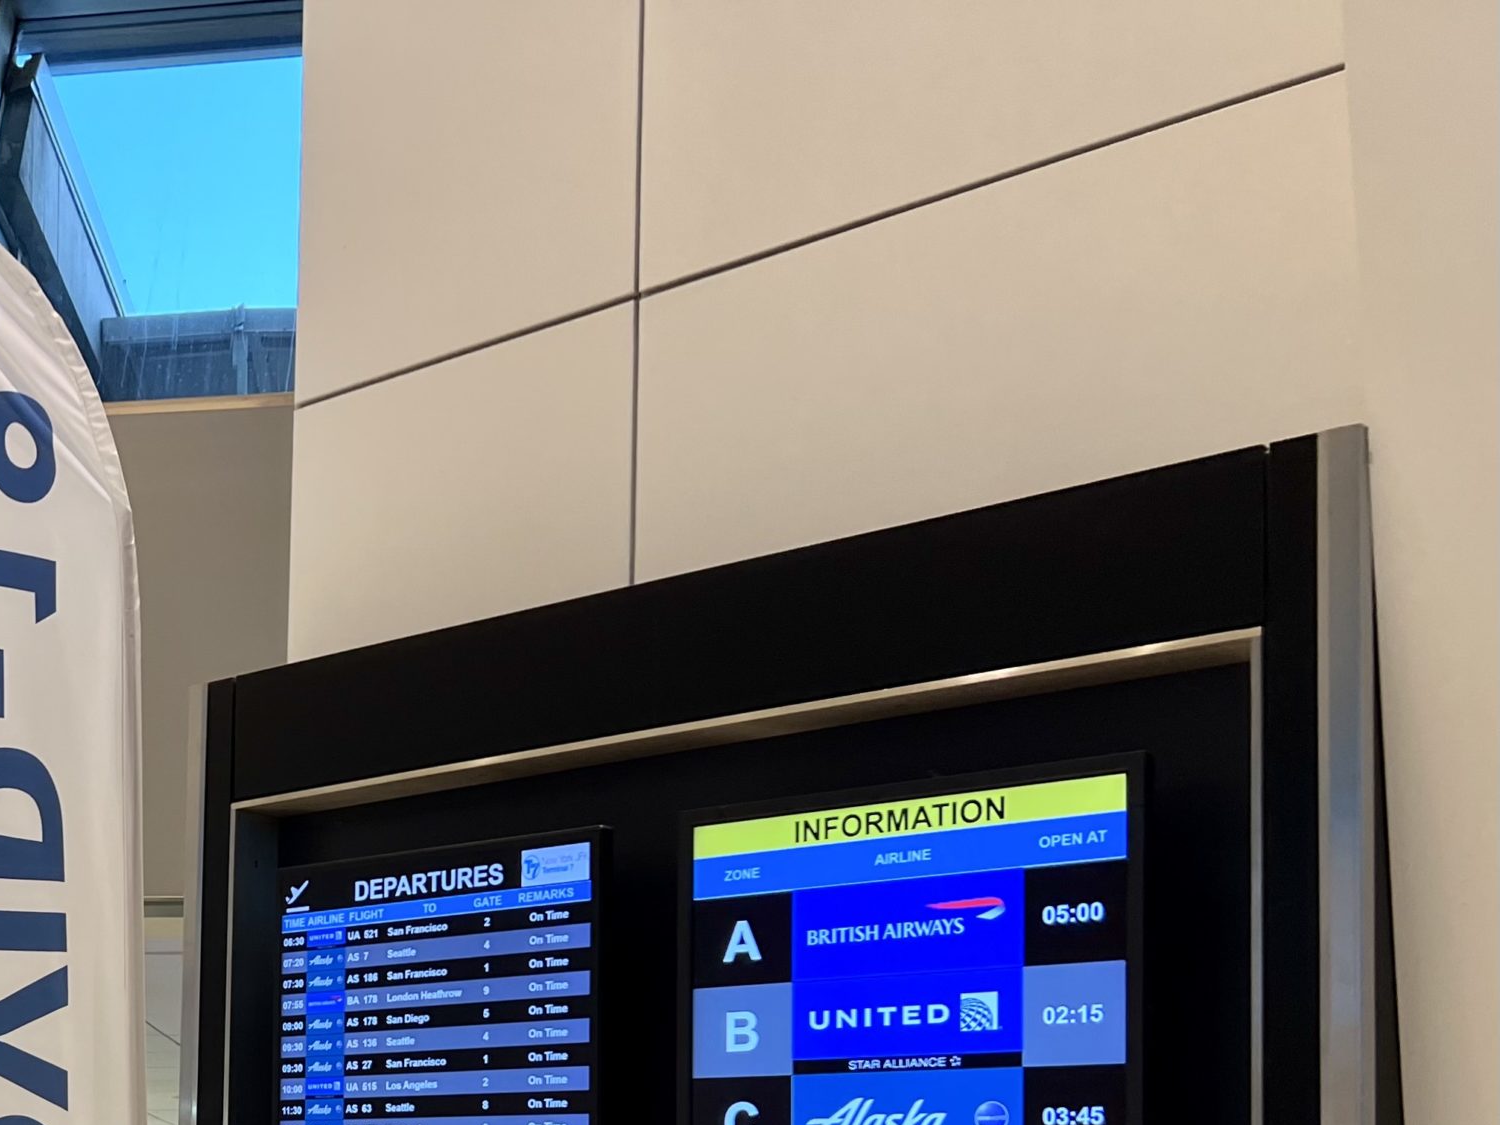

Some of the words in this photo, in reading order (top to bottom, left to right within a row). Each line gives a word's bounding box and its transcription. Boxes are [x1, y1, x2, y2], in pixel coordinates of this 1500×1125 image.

[794, 796, 1006, 843] INFORMATION
[724, 867, 760, 881] ZONE
[874, 849, 931, 865] AIRLINE
[1038, 832, 1082, 849] OPEN
[1085, 830, 1108, 844] AT
[354, 863, 504, 901] DEPARTURES
[284, 918, 305, 928] TIME
[308, 913, 344, 926] AIRLINE
[349, 909, 384, 921] FLIGHT
[423, 903, 437, 913] TO
[473, 895, 502, 908] GATE
[518, 887, 574, 903] REMARKS
[347, 931, 360, 940] UA
[387, 927, 404, 937] San
[405, 922, 448, 935] Francisco
[483, 917, 491, 927] 2
[529, 912, 544, 922] On
[545, 910, 570, 920] Time
[722, 921, 762, 963] A
[807, 924, 879, 946] BRITISH
[883, 918, 965, 939] AIRWAYS
[1042, 902, 1104, 925] 05:00
[347, 953, 360, 962] AS
[387, 948, 416, 958] Seattle
[483, 940, 490, 950] 4
[529, 936, 544, 945] On
[545, 934, 570, 944] Time
[346, 974, 360, 984] AS
[386, 972, 404, 981] San
[404, 968, 448, 979] Francisco
[483, 962, 490, 972] 1
[528, 959, 543, 968] On
[545, 957, 570, 967] Time
[386, 991, 419, 1002] London
[420, 989, 462, 1000] Heathrow
[528, 982, 543, 992] On
[544, 980, 569, 990] Time
[346, 1018, 359, 1027] AS
[386, 1015, 403, 1024] San
[404, 1013, 430, 1024] Diego
[528, 1005, 543, 1015] On
[544, 1004, 568, 1014] Time
[726, 1012, 759, 1053] B
[809, 1004, 950, 1030] UNITED
[1043, 1005, 1103, 1024] 02:15
[346, 1039, 358, 1048] AS
[386, 1036, 416, 1046] Seattle
[482, 1032, 490, 1041] 4
[528, 1029, 542, 1038] On
[544, 1028, 569, 1038] Time
[346, 1061, 358, 1070] AS
[386, 1059, 402, 1069] San
[404, 1057, 447, 1068] Francisco
[482, 1054, 489, 1064] 1
[528, 1052, 542, 1062] On
[544, 1050, 569, 1062] Time
[848, 1059, 881, 1070] STAR
[883, 1057, 946, 1069] ALLIANCE
[346, 1082, 358, 1092] UA
[386, 1081, 402, 1090] Los
[402, 1080, 438, 1091] Angeles
[482, 1077, 490, 1087] 2
[528, 1076, 542, 1085] On
[544, 1074, 568, 1084] Time
[345, 1104, 358, 1114] AS
[385, 1102, 415, 1113] Seattle
[528, 1098, 542, 1108] On
[544, 1098, 568, 1108] Time
